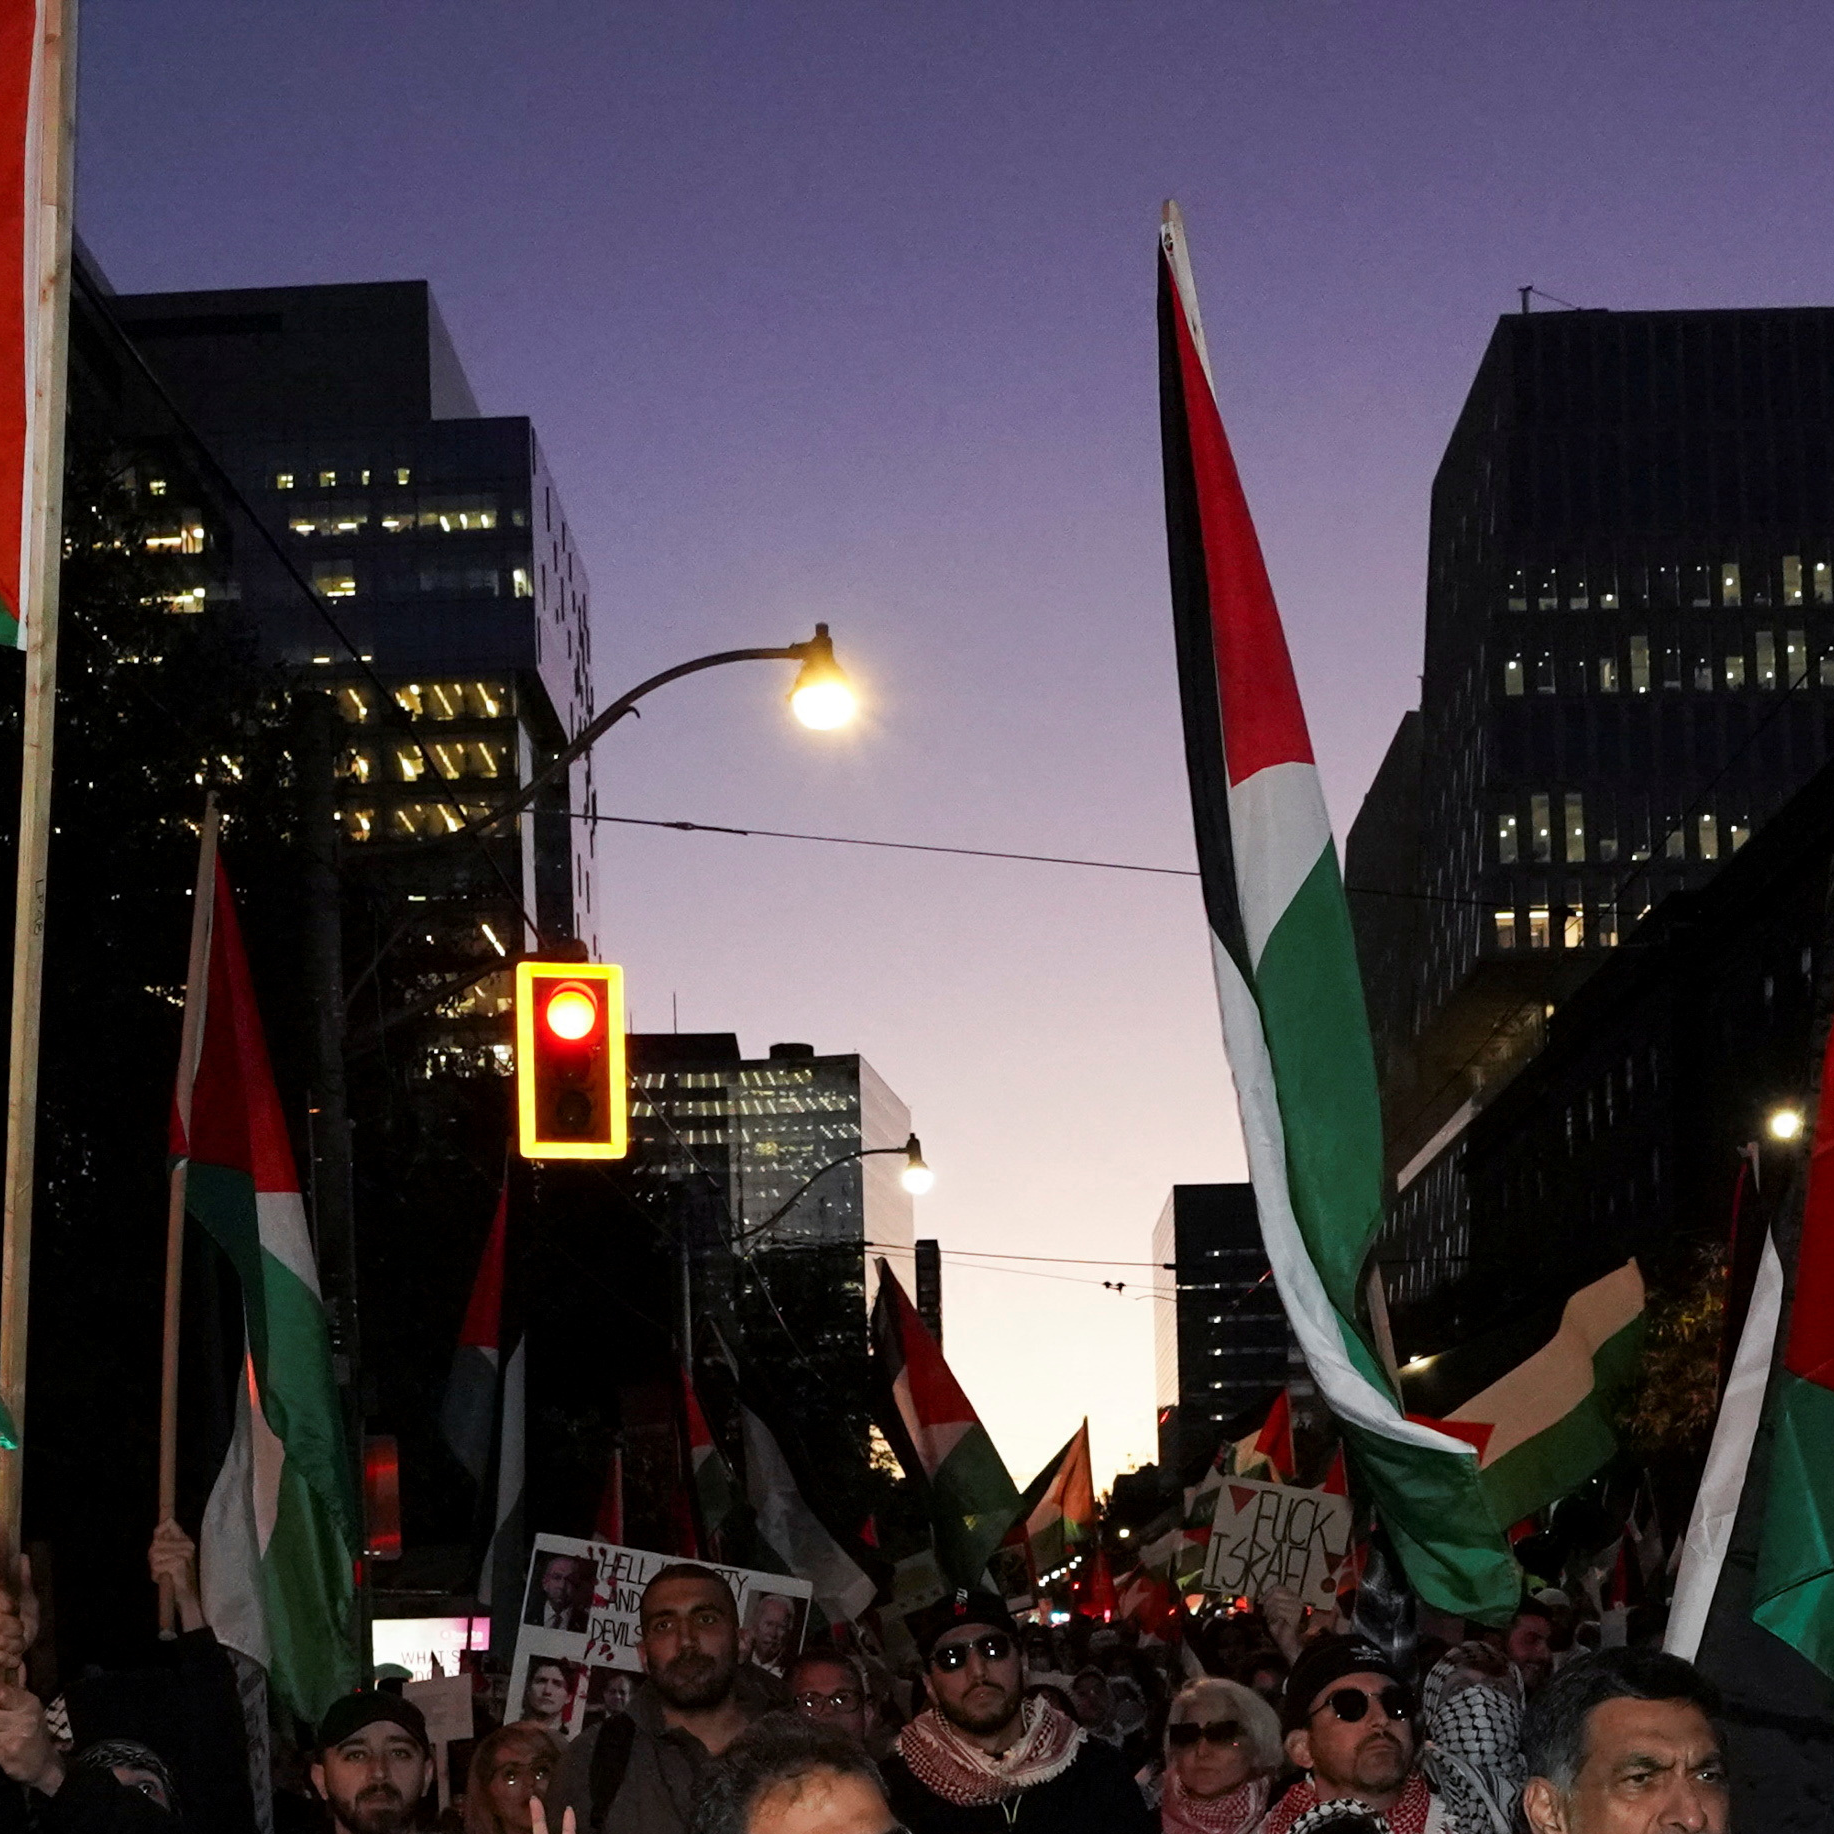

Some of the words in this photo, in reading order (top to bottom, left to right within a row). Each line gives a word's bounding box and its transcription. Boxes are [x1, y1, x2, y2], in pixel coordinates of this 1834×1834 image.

[1253, 1490, 1335, 1552] FUCK
[599, 1552, 648, 1585] HELL
[607, 1588, 642, 1613] AND
[591, 1618, 644, 1648] DEVILS
